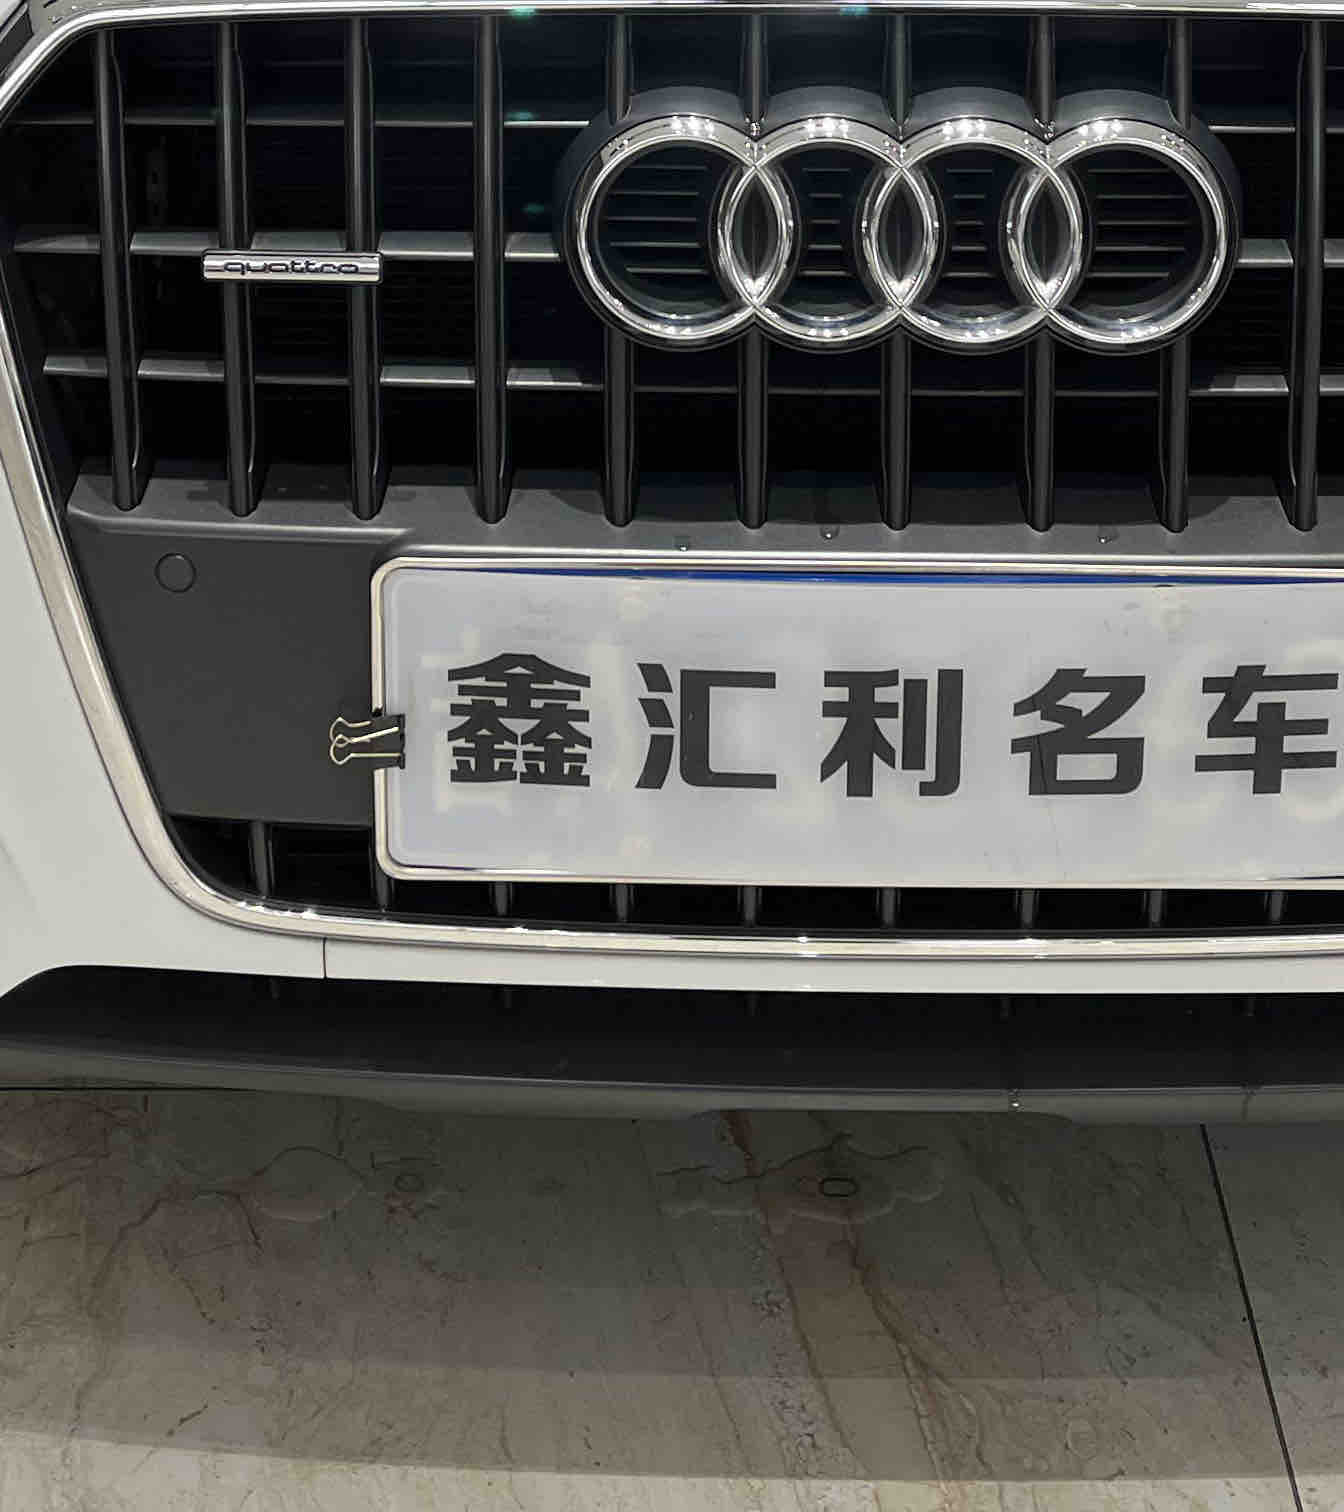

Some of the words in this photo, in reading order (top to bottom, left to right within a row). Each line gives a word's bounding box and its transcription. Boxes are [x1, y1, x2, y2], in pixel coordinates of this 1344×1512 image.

[224, 260, 359, 276] quattro
[447, 652, 1339, 798] 鑫汇利名车
